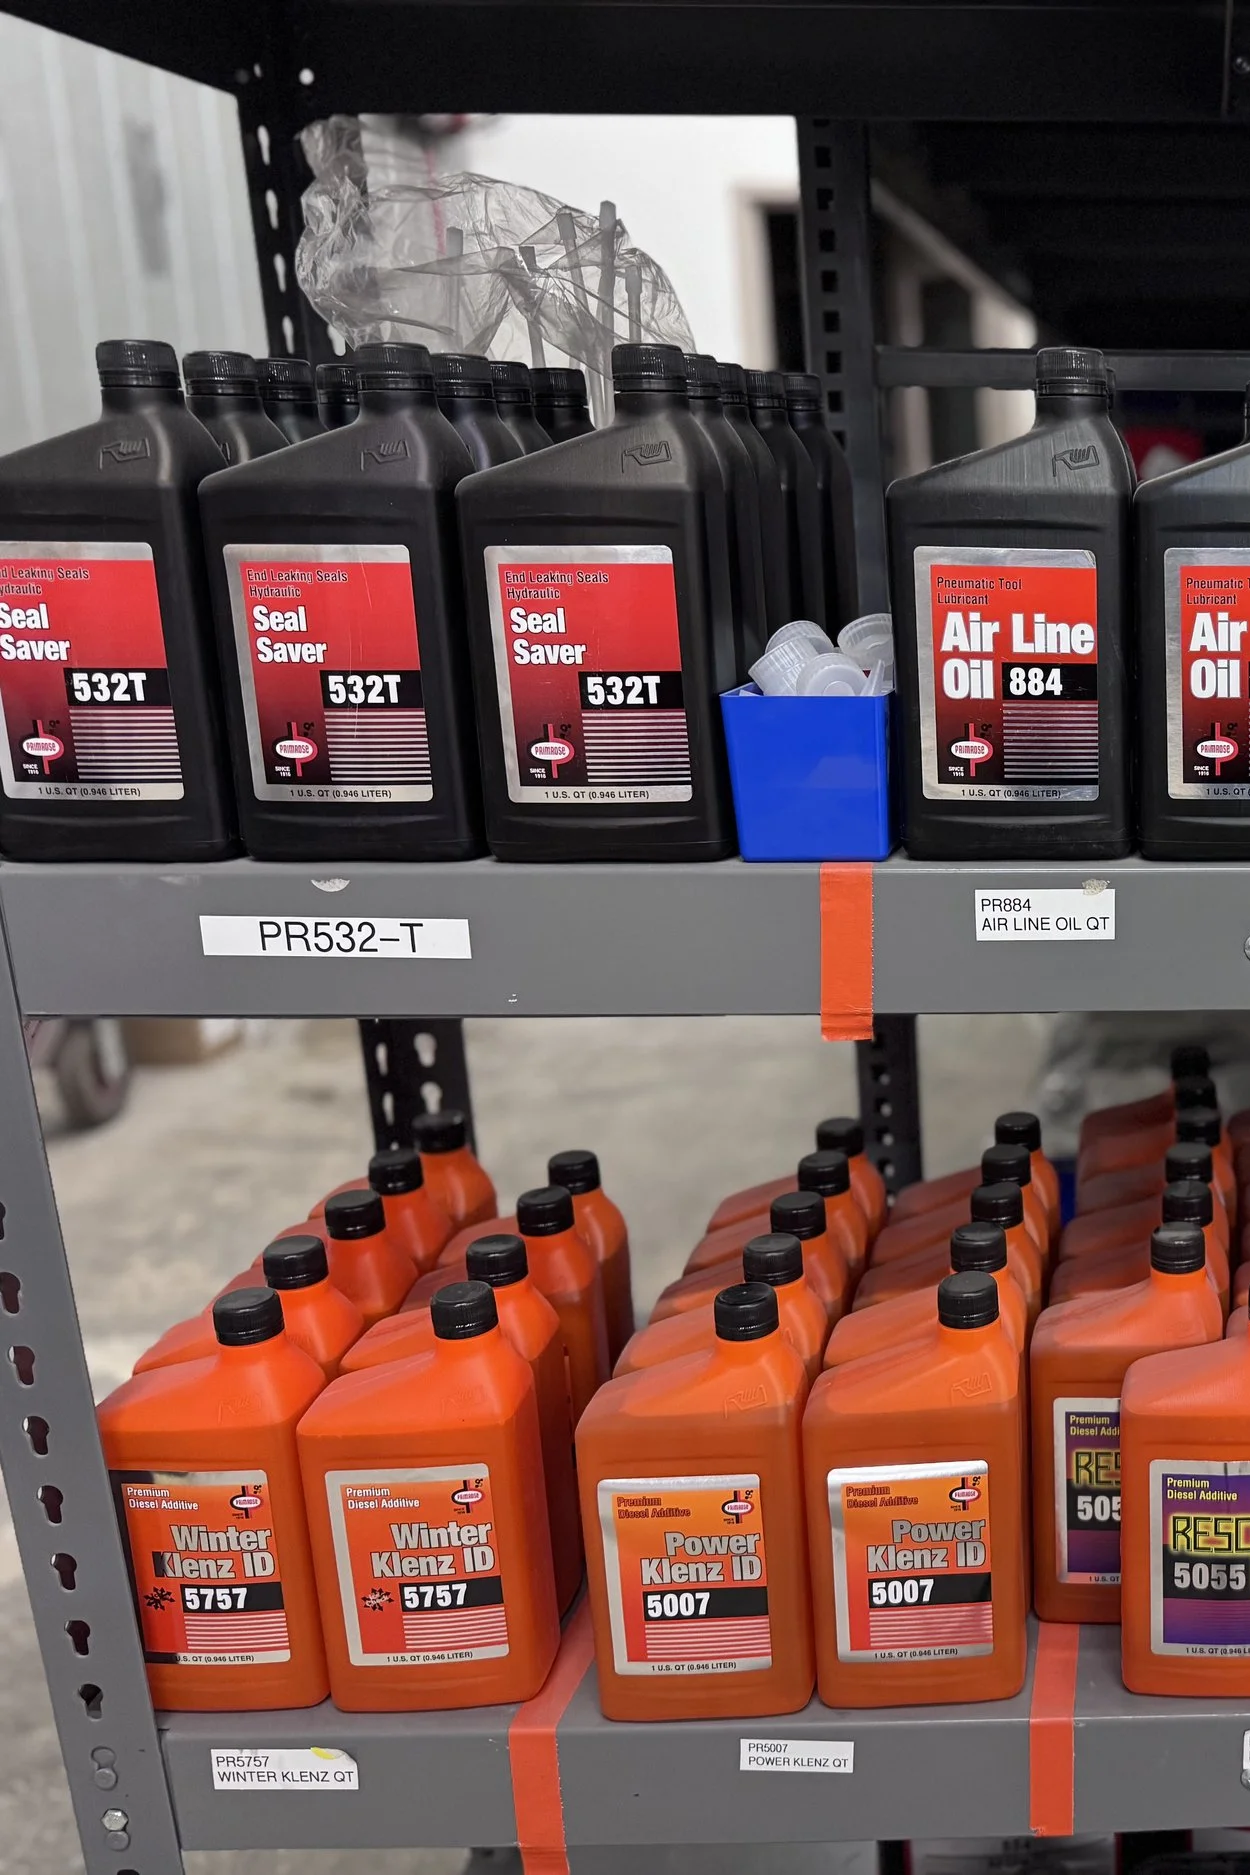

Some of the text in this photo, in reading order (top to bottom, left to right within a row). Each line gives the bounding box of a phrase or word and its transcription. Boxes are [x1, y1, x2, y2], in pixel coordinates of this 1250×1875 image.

[505, 572, 609, 586] End Leaking Seals
[937, 576, 1022, 590] Pneumatic Tool
[507, 587, 560, 601] Hydraulic
[937, 593, 989, 605] Lubricant
[252, 605, 308, 631] Seal
[510, 607, 566, 634] Seal
[940, 611, 1095, 655] Air Line
[1189, 612, 1248, 652] Air
[1, 634, 71, 661] Saver
[256, 636, 327, 663] Saver
[513, 639, 587, 665] Saver
[72, 672, 147, 701] 532T
[328, 674, 401, 704] 532T
[587, 676, 661, 705] 532T
[942, 658, 995, 700] Oil
[1009, 667, 1063, 696] 884
[1190, 659, 1241, 699] Oil
[552, 791, 570, 799] U.S.
[573, 791, 586, 799] QT
[589, 790, 616, 800] (0.946
[619, 790, 649, 799] LITER)
[981, 898, 1031, 912] PR884
[982, 917, 1109, 931] AIR LINE OIL QT
[259, 921, 423, 953] PR532-T
[346, 1487, 390, 1497] Premium
[1167, 1478, 1209, 1488] Premium
[1167, 1490, 1238, 1501] Diesel Additive
[347, 1498, 420, 1509] Diesel Additive
[169, 1524, 272, 1552] Winter
[389, 1521, 493, 1550] Winter
[892, 1519, 986, 1544] Power
[664, 1532, 760, 1557] Power
[867, 1541, 986, 1573] Klenz ID
[152, 1551, 275, 1579] Klenz ID
[370, 1546, 495, 1578] Klenz ID
[640, 1555, 762, 1585] Klenz ID
[1174, 1562, 1246, 1590] 5055
[184, 1587, 247, 1610] 5757
[403, 1583, 468, 1608] 5757
[872, 1579, 934, 1604] 5007
[647, 1592, 710, 1617] 5007
[748, 1743, 788, 1753] PR5007
[216, 1756, 269, 1767] PR5757
[748, 1756, 848, 1768] POWER KLENZ QT
[218, 1771, 354, 1782] WINTER KLENZ QT
